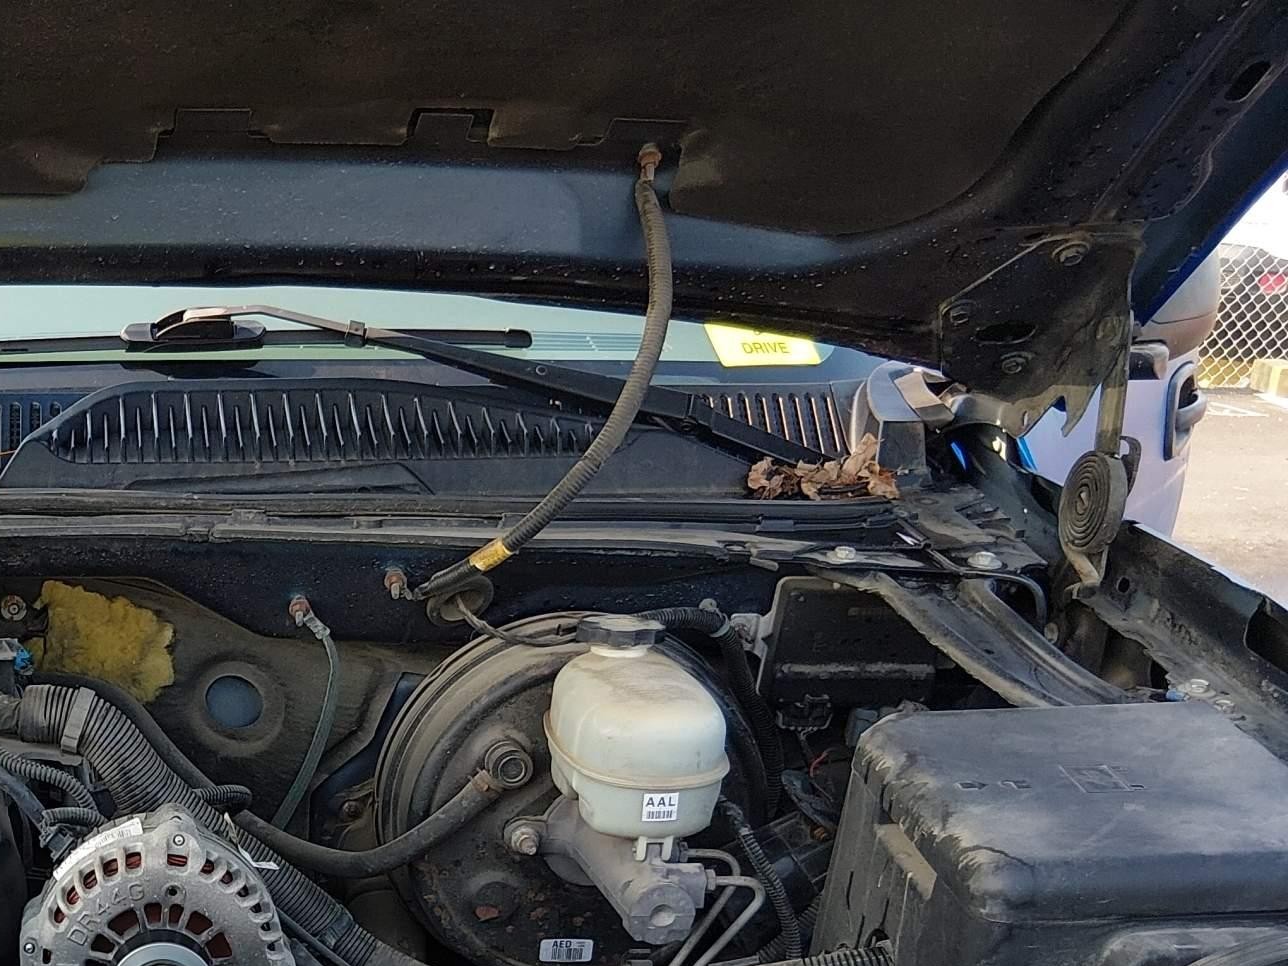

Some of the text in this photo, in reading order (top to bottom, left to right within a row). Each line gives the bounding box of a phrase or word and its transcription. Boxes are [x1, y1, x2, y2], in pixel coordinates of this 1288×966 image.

[741, 342, 790, 354] DRIVE
[645, 796, 676, 807] AAL
[552, 940, 572, 949] AED
